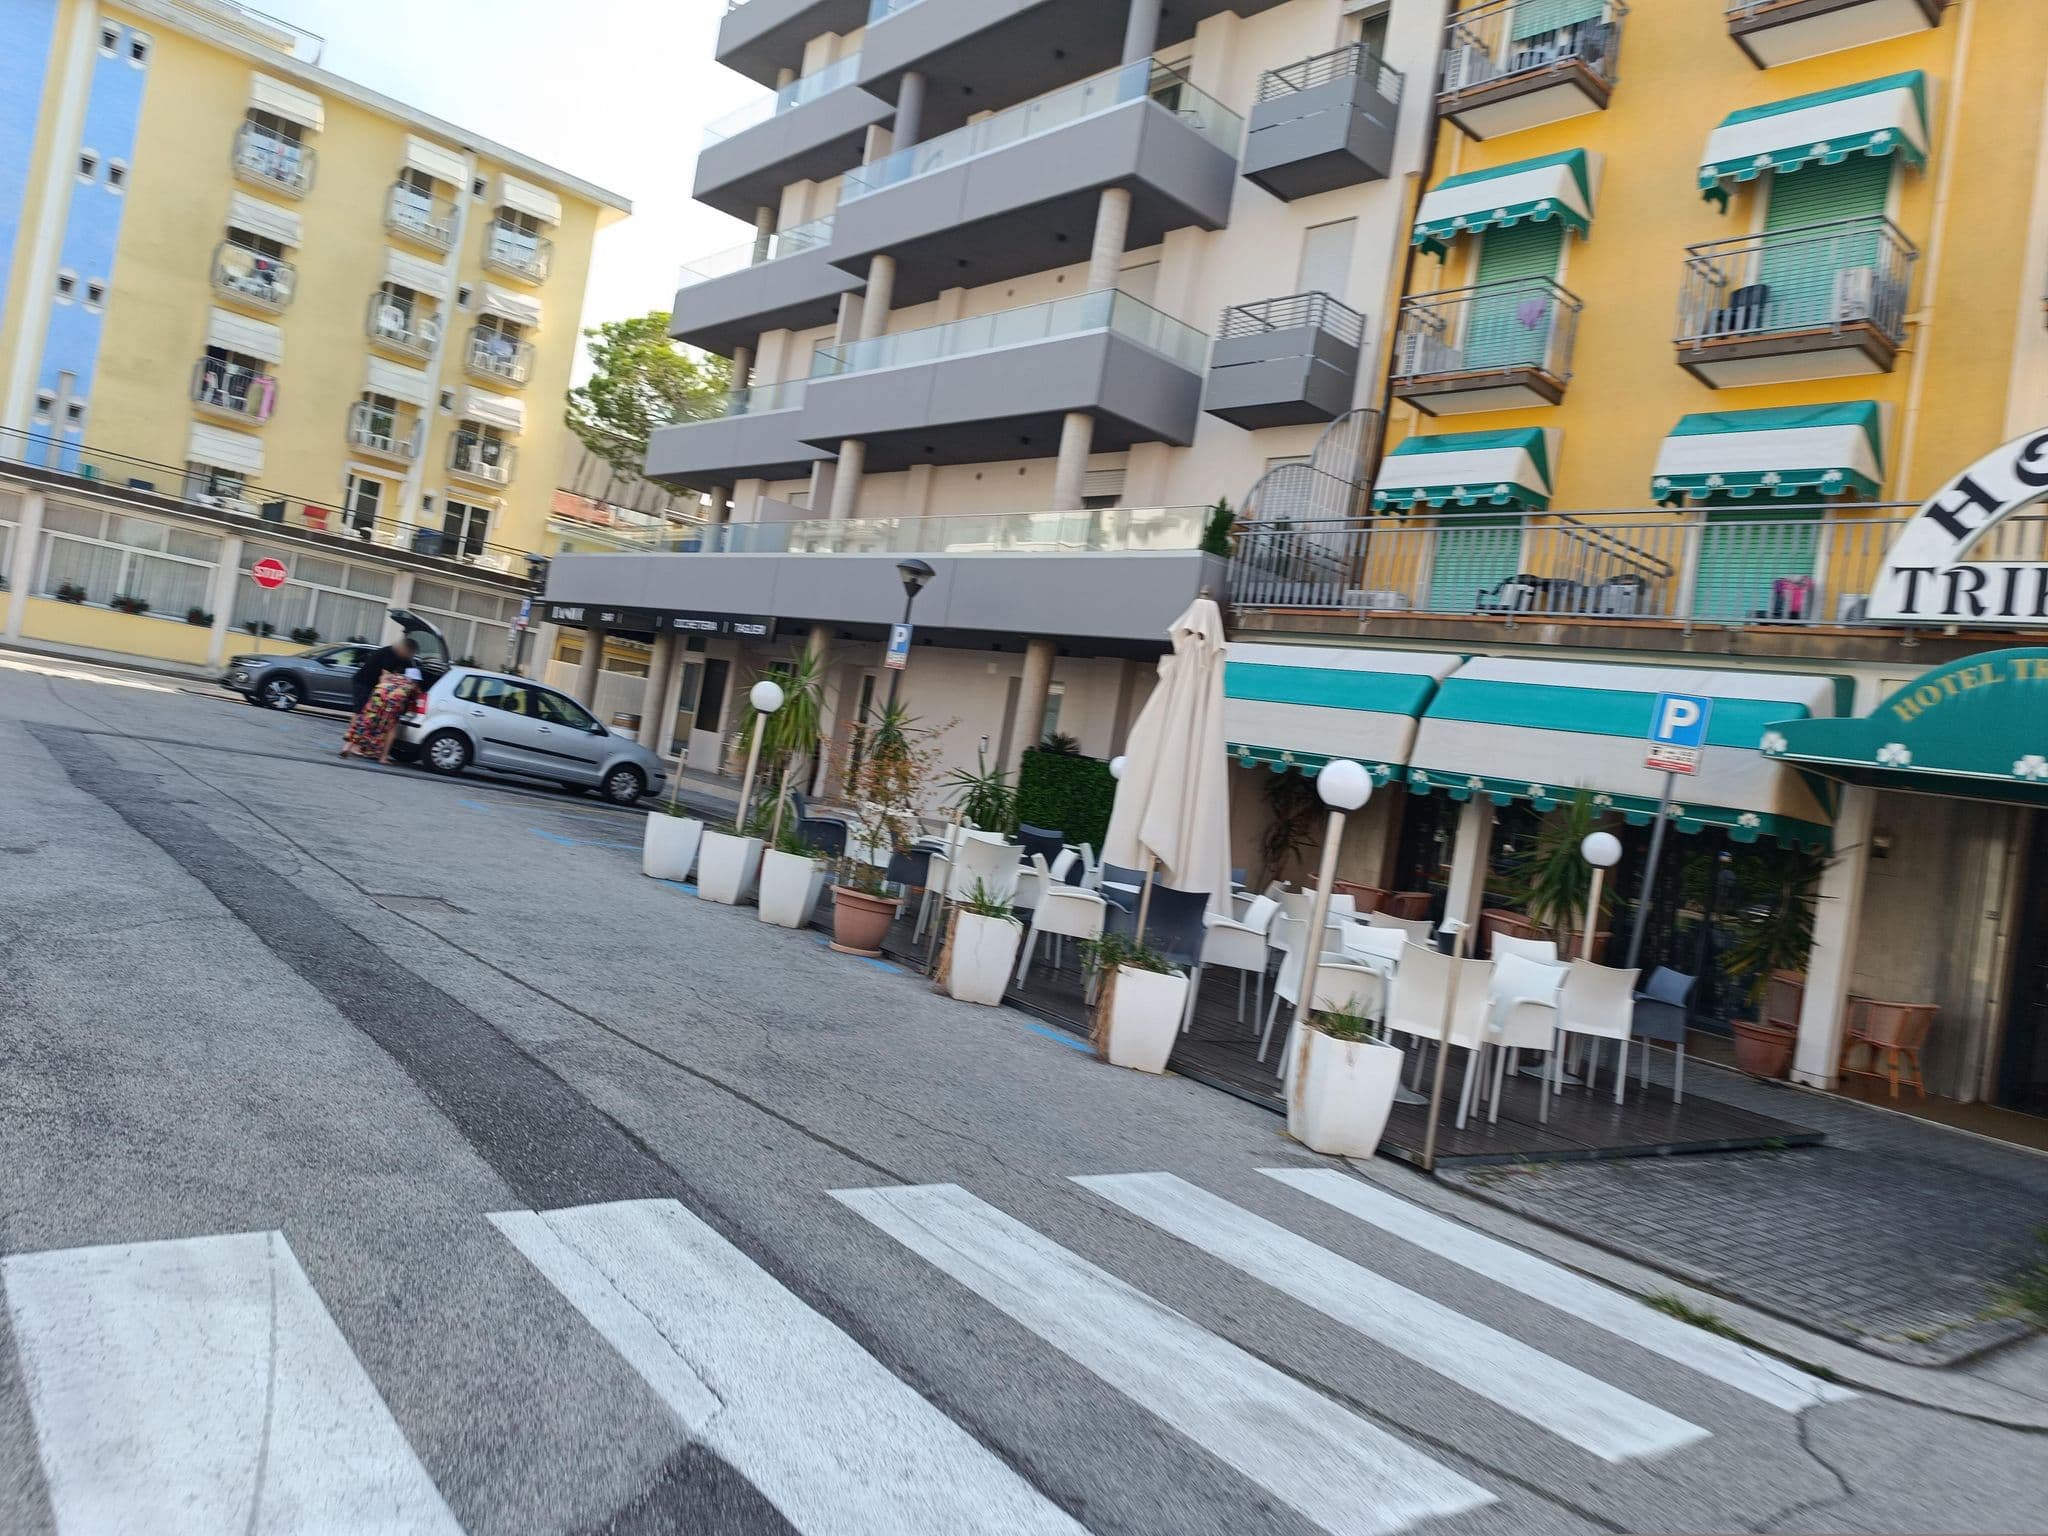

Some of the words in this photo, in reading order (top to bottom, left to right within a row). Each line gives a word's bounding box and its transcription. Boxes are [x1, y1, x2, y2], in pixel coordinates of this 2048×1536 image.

[254, 565, 287, 581] STOP
[890, 626, 908, 651] P
[1892, 663, 2005, 721] HOTEL
[1658, 698, 1700, 739] P
